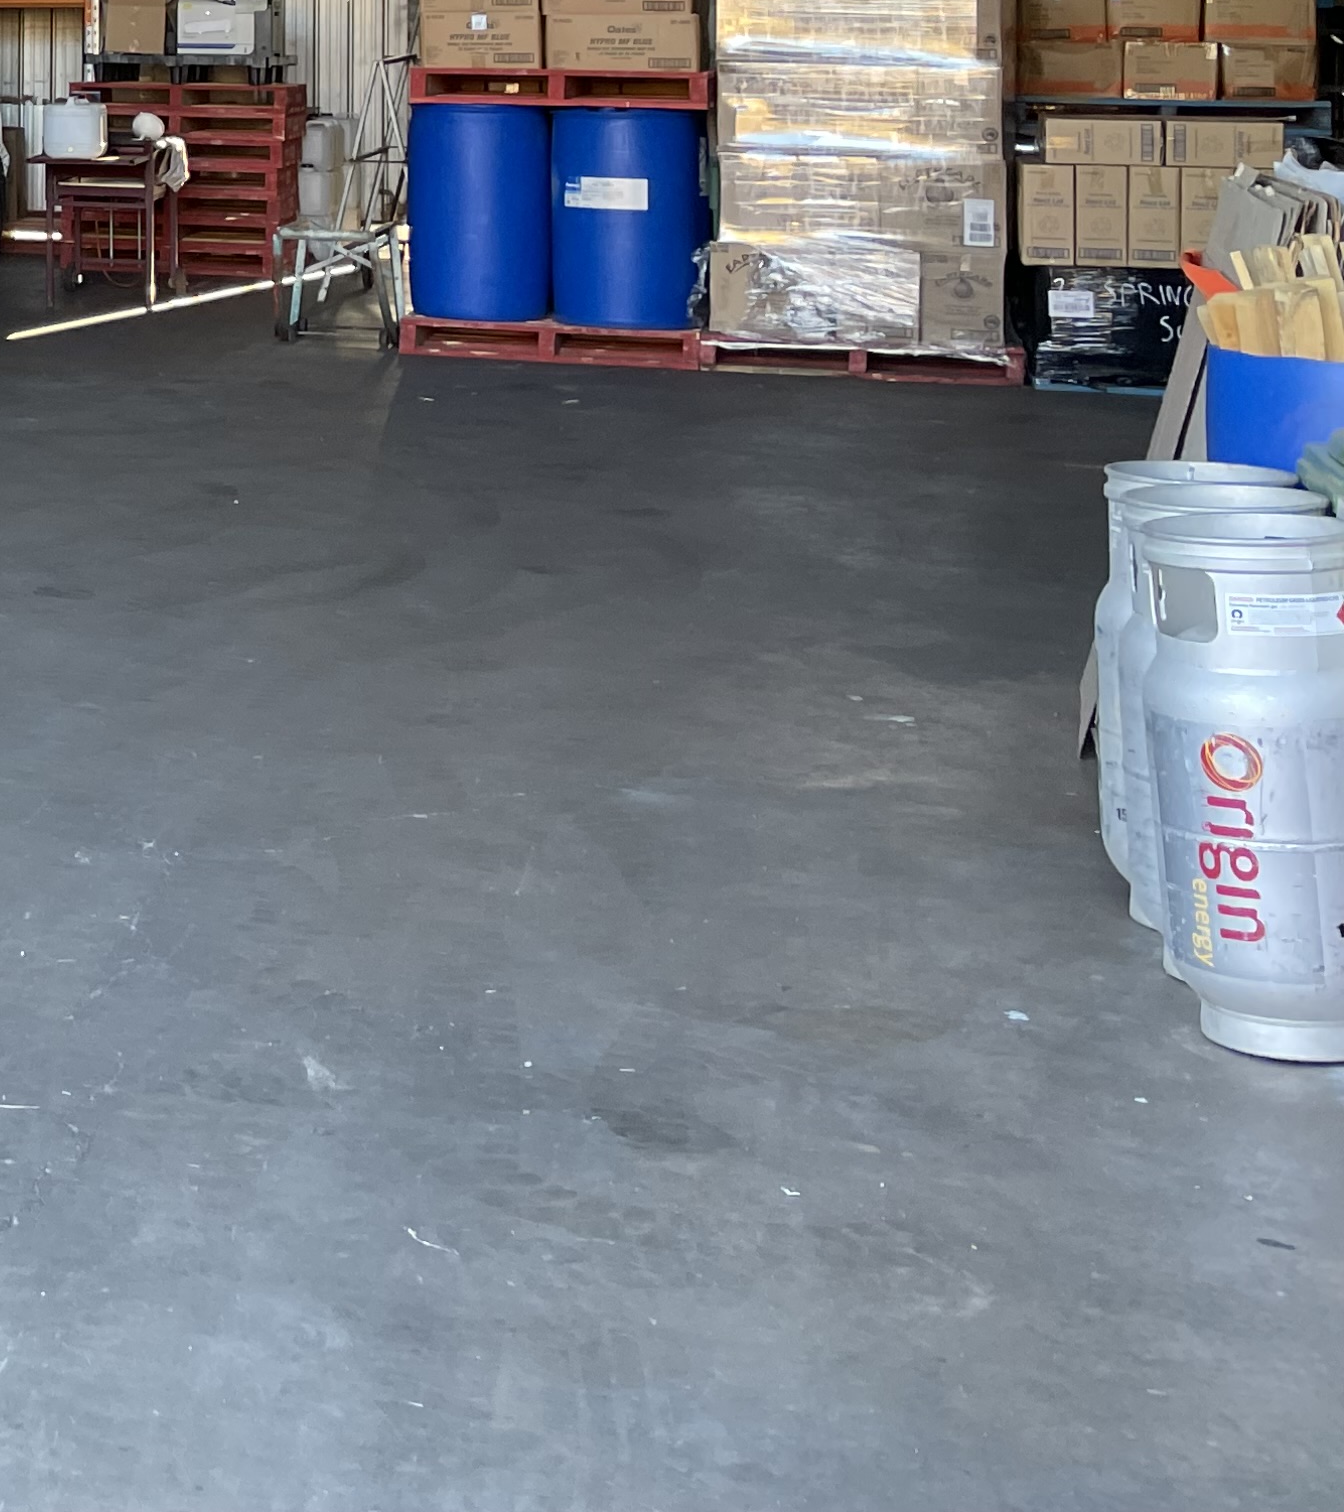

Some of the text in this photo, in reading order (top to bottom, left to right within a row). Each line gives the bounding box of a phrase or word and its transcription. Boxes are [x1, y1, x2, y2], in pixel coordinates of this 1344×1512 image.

[607, 25, 637, 34] Oates
[1199, 732, 1265, 942] Origin
[1192, 878, 1214, 968] energy
